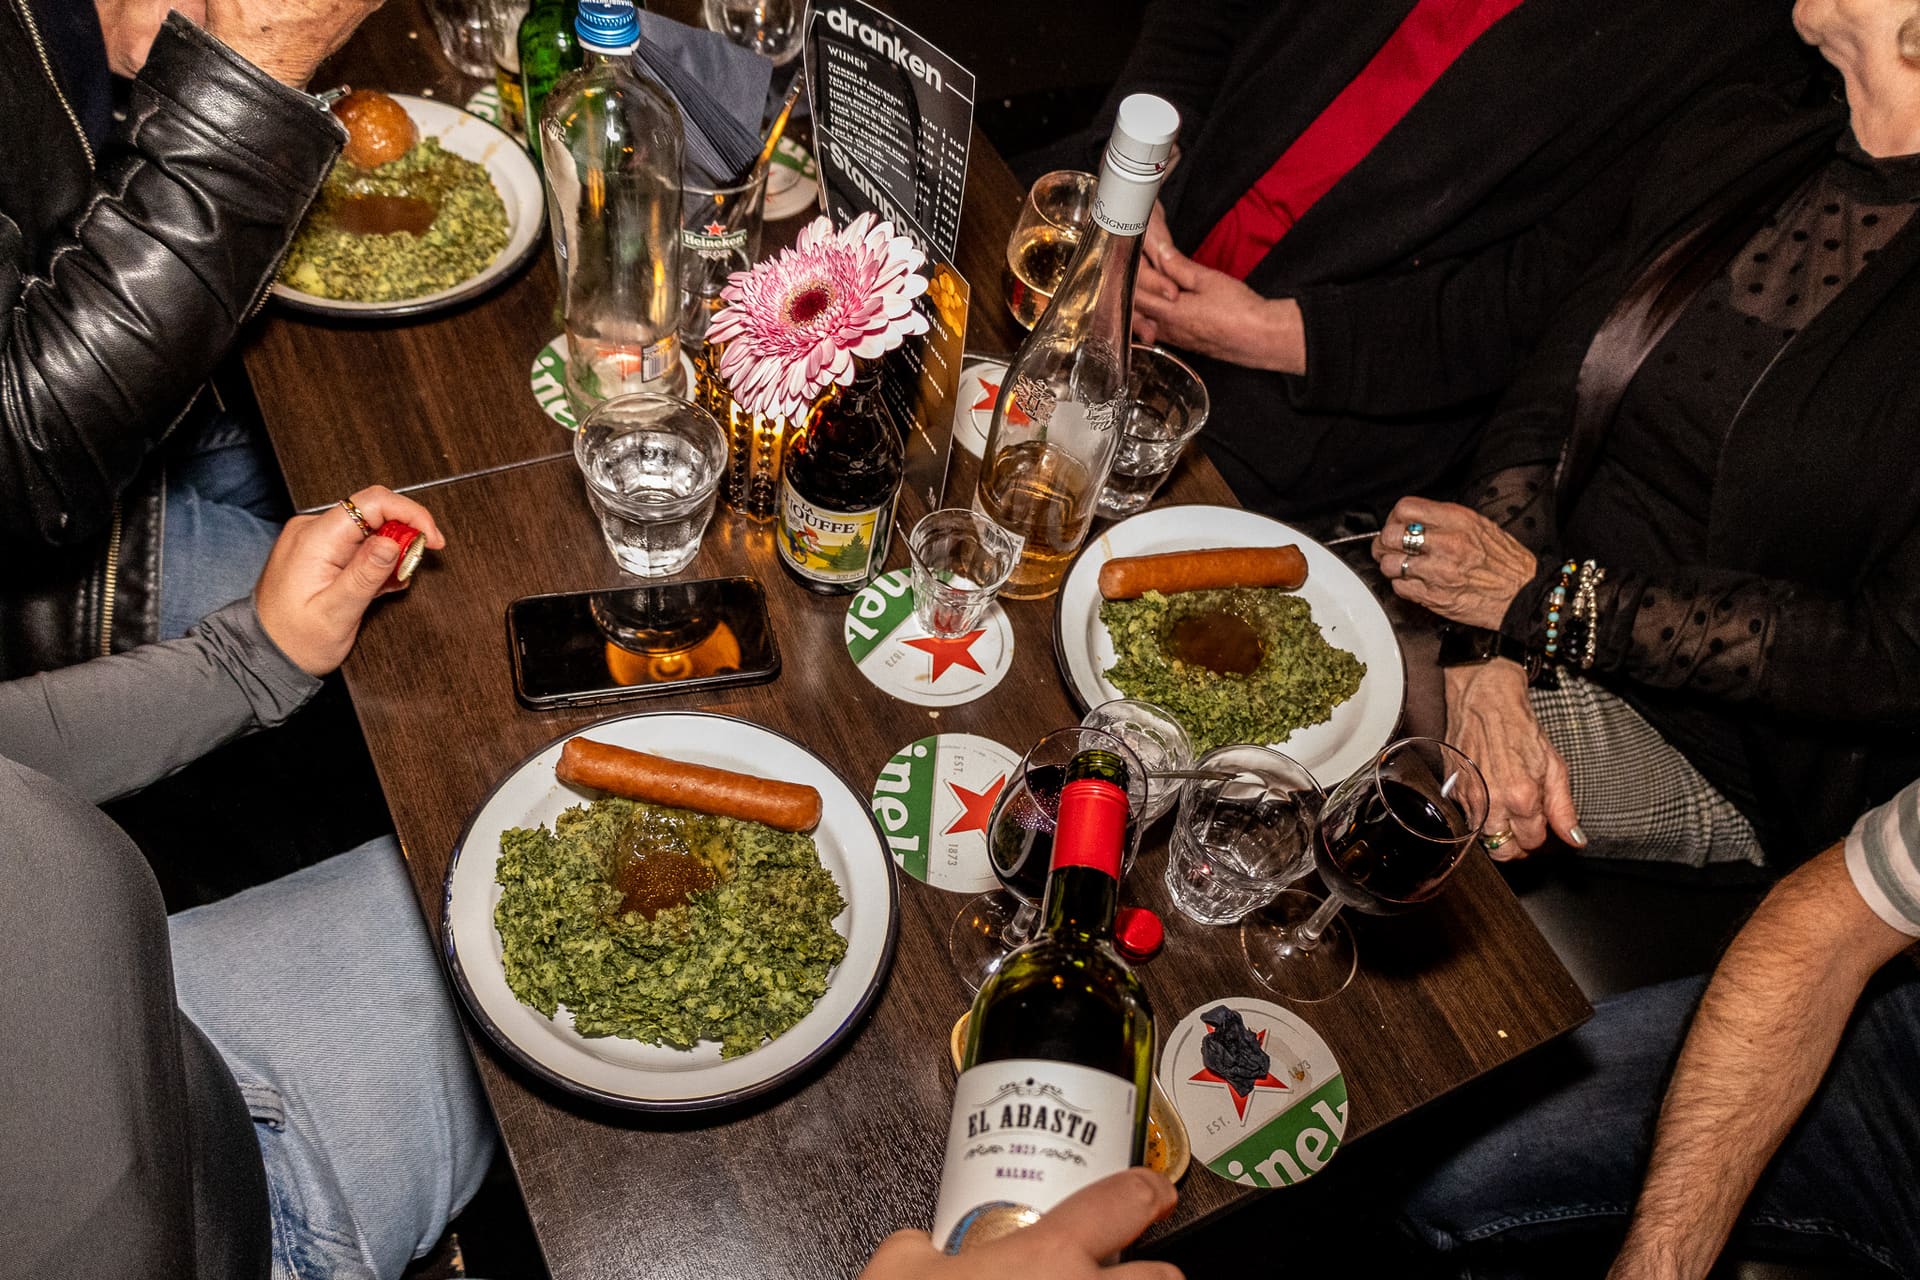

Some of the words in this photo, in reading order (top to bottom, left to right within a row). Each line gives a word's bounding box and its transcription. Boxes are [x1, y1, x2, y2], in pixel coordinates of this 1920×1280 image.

[827, 8, 942, 92] dranken
[828, 45, 868, 72] WIJNEN
[684, 233, 745, 249] Heineken
[884, 649, 905, 668] 1873
[947, 843, 959, 866] 1873
[967, 1108, 991, 1139] EL
[1000, 1103, 1099, 1147] ABASTO
[1205, 1115, 1231, 1136] EST.
[996, 1167, 1044, 1182] MALBEC
